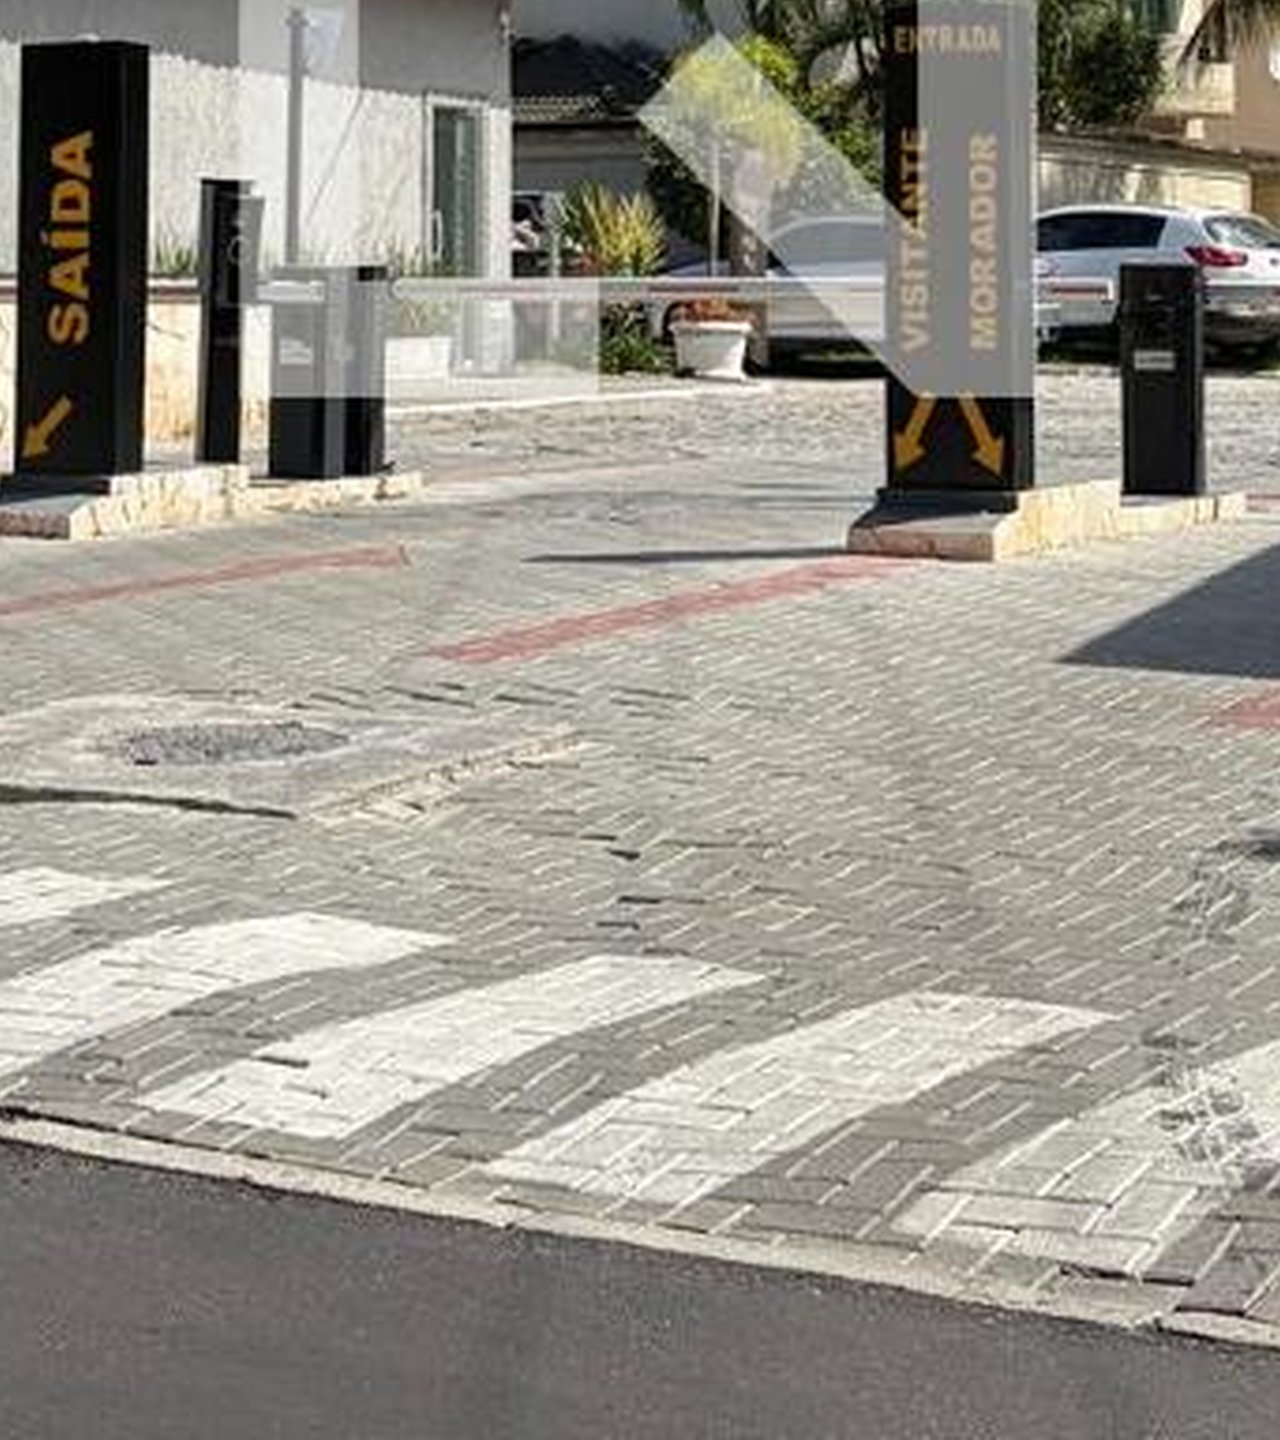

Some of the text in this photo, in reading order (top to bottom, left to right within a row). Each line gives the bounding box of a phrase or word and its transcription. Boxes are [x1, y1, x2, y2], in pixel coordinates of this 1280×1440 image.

[893, 25, 1001, 54] ENTRADA
[41, 130, 94, 344] SAÍDA
[900, 129, 928, 352] VISITANTE
[969, 132, 999, 351] MORADOR
